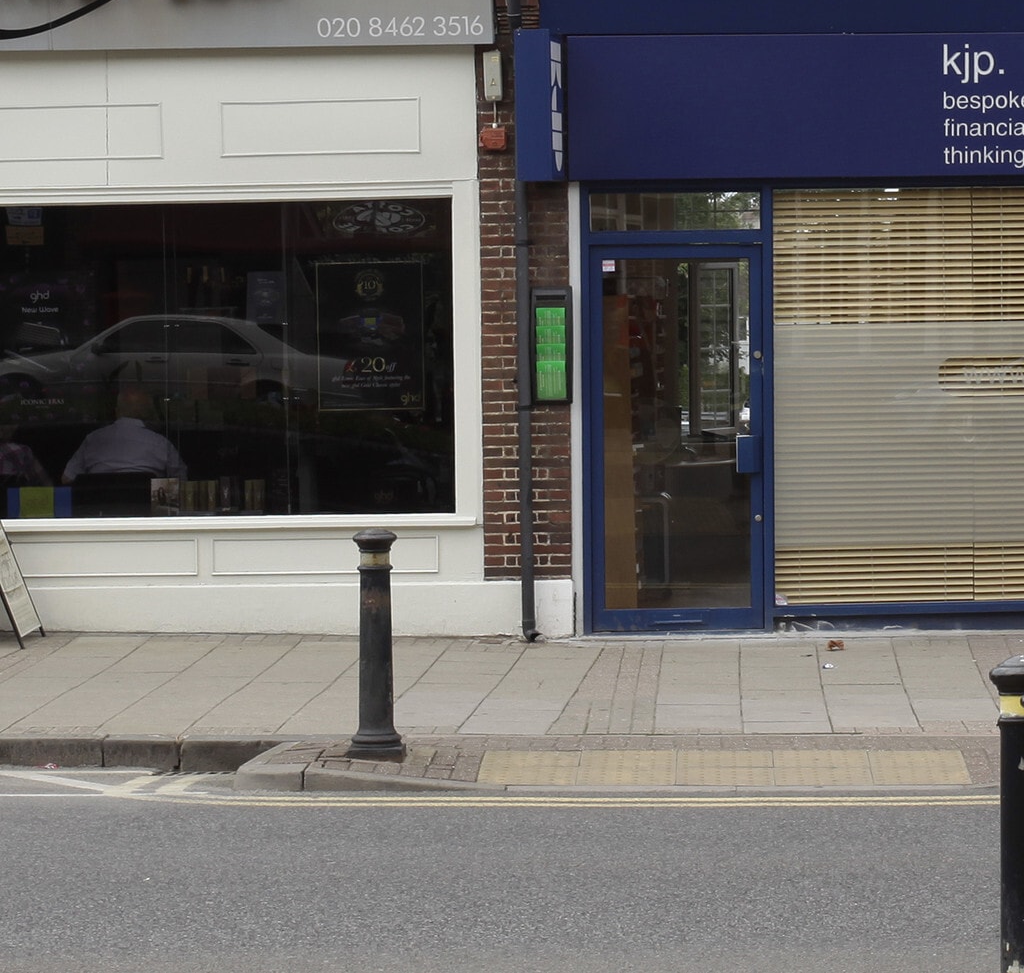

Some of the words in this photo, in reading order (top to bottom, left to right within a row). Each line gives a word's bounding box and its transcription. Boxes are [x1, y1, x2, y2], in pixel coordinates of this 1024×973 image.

[317, 17, 361, 38] 020
[368, 16, 425, 37] 8462
[433, 15, 484, 36] 3516
[943, 43, 1005, 84] kjp.
[30, 290, 50, 303] ghd
